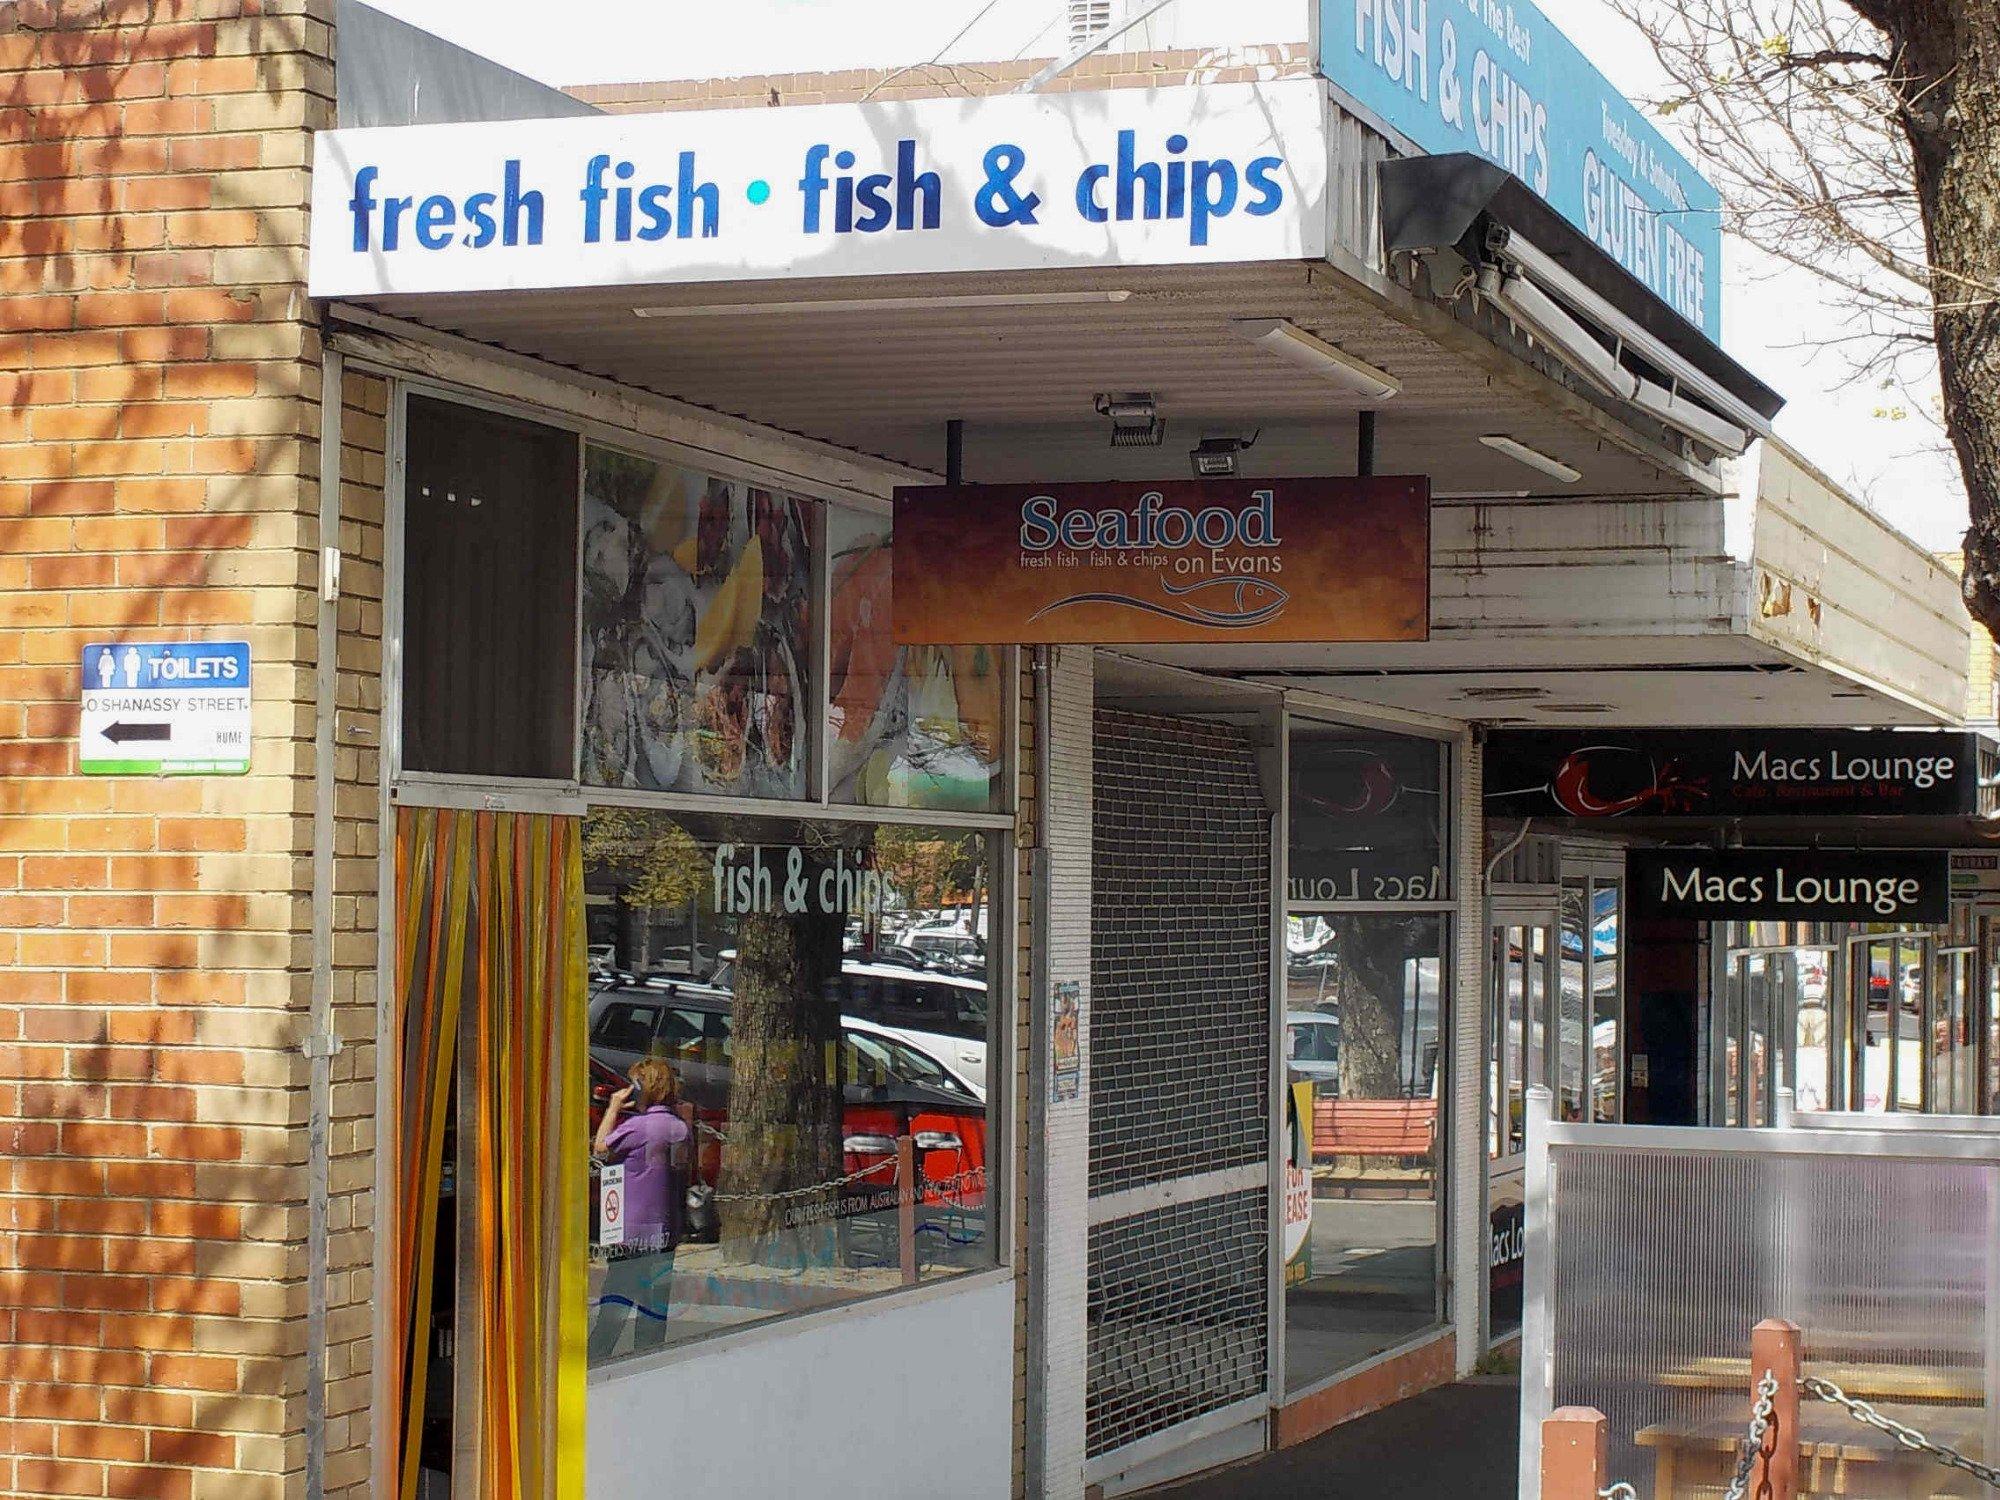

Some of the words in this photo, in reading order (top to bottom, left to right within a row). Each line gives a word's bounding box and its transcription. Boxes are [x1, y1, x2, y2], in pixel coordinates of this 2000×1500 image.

[1355, 0, 1428, 103] FISH
[1438, 19, 1462, 130] &
[1471, 49, 1548, 200] CHIPS
[348, 159, 546, 253] fresh
[579, 151, 719, 243] fish
[798, 139, 942, 235] fish
[973, 144, 1041, 228] &
[1074, 129, 1285, 247] chips
[1583, 150, 1661, 297] GLUTEN
[1666, 223, 1705, 329] FREE
[1019, 489, 1282, 551] Seafood
[1020, 553, 1052, 568] fresh
[1057, 553, 1079, 567] fish
[1090, 552, 1112, 566] fish
[1116, 552, 1128, 566] &
[1133, 552, 1169, 571] chips
[1174, 556, 1206, 574] on
[1211, 549, 1283, 573] Evans
[147, 655, 239, 680] TOILETS
[101, 697, 180, 712] SHANASSY
[188, 697, 245, 711] STREET
[1732, 750, 1821, 781] Macs
[1830, 750, 1955, 788] Lounge
[712, 843, 773, 914] fish
[783, 846, 810, 914] &
[818, 849, 896, 934] chips
[1661, 868, 1764, 902] Macs
[1776, 868, 1920, 914] Lounge
[1286, 1189, 1309, 1225] EASE
